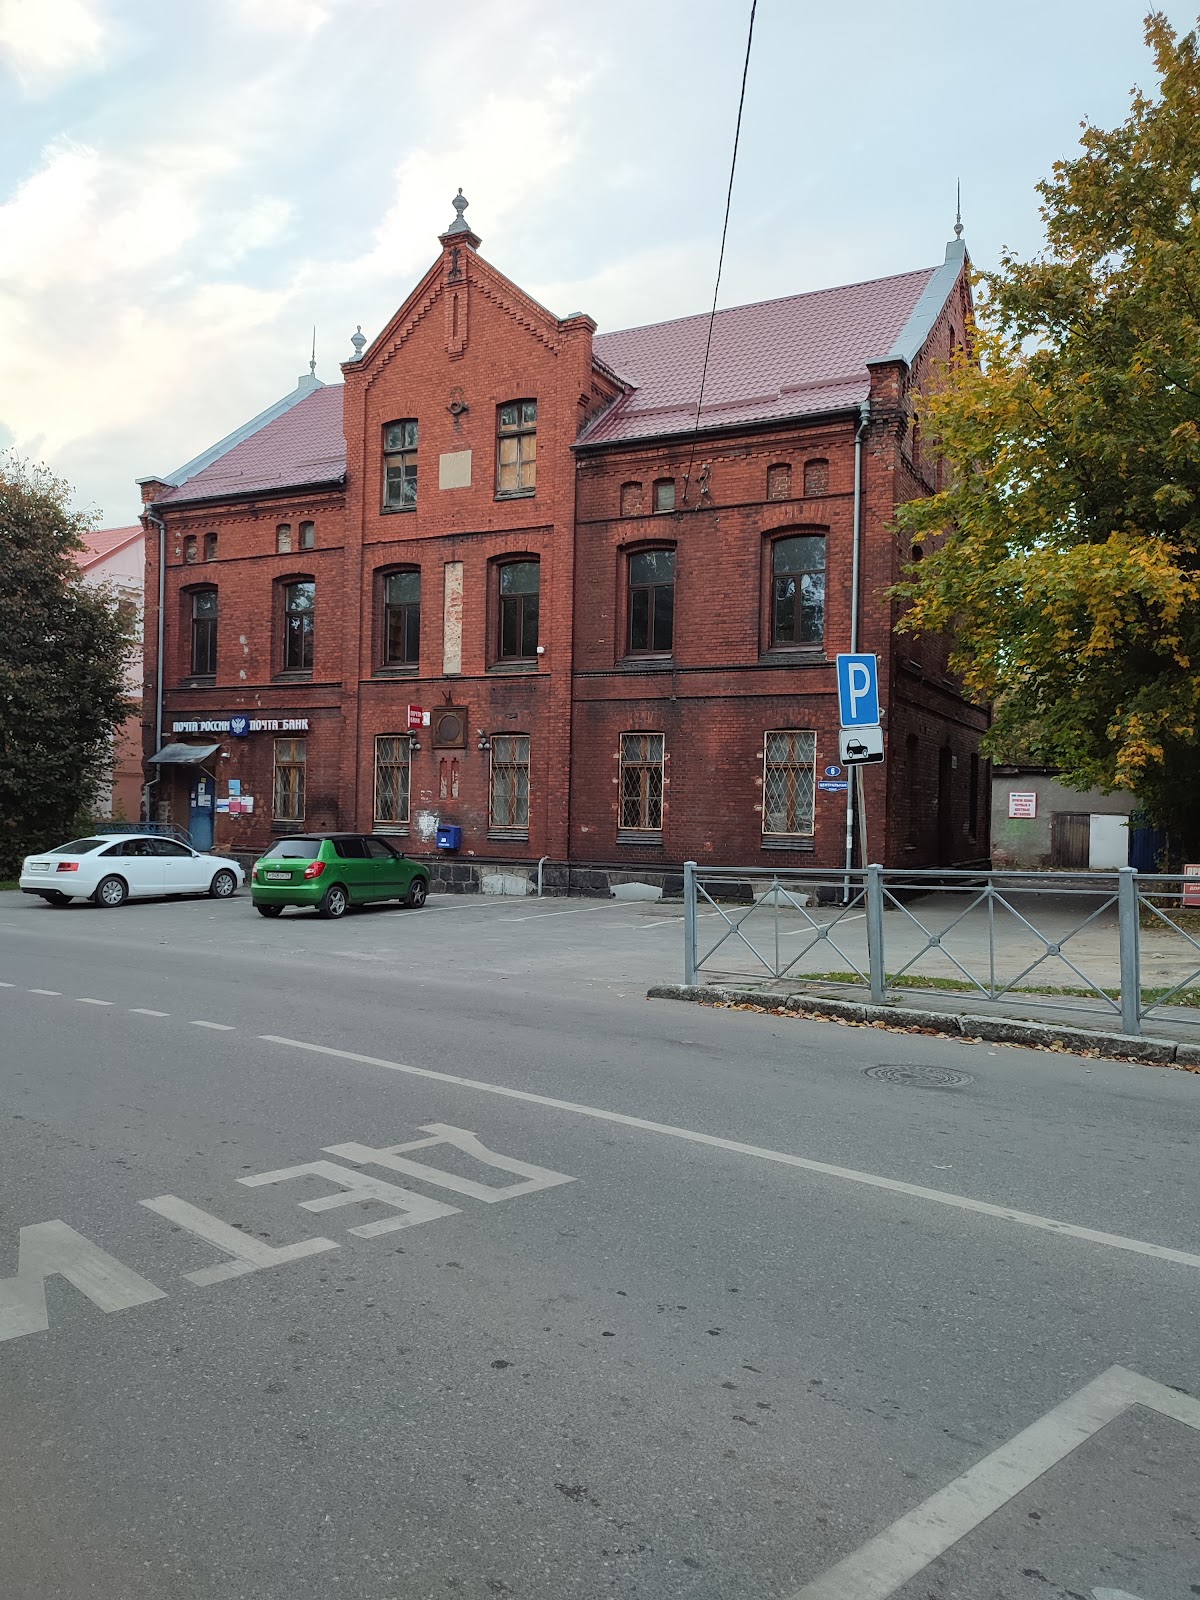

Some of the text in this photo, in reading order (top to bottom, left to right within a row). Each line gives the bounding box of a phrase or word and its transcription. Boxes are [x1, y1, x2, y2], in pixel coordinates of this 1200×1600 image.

[848, 662, 870, 718] P
[173, 720, 230, 732] ПОЧТА РОССИИ
[249, 718, 309, 731] ПОЧТА БАНК
[830, 767, 836, 775] 6
